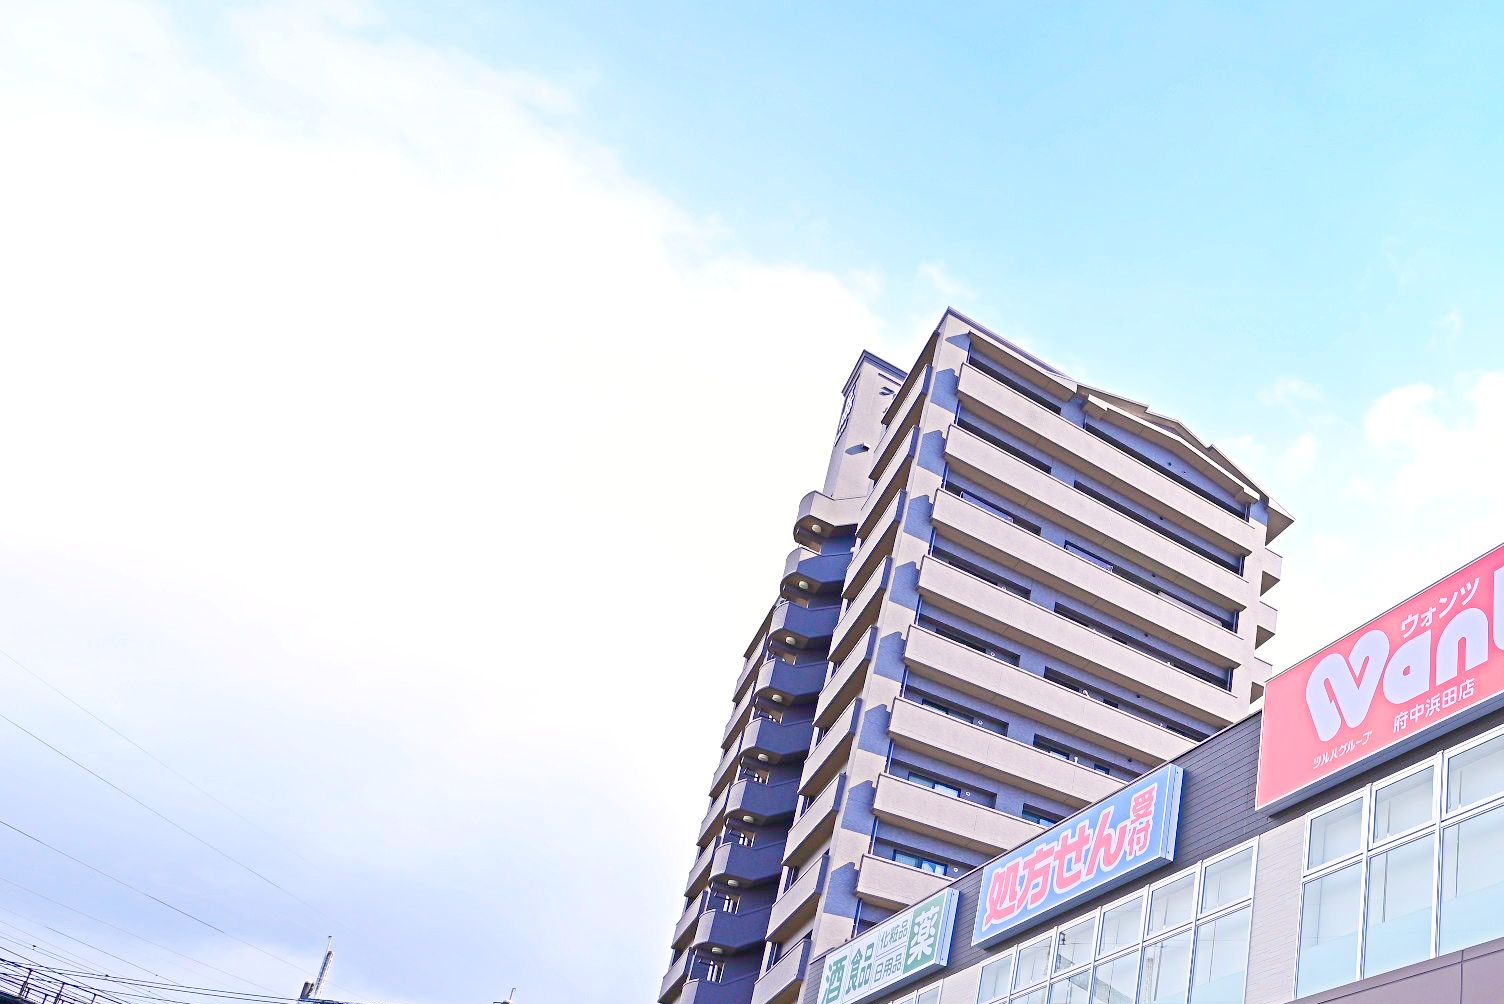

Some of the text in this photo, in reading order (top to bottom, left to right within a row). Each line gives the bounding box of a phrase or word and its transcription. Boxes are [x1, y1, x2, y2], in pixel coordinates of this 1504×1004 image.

[1400, 576, 1480, 638] ウォンツ
[1392, 677, 1475, 733] 府中浜田店
[1312, 730, 1373, 769] ツルハグループ
[880, 919, 910, 949] 化粧品
[907, 906, 940, 966] 薬
[874, 952, 903, 982] 日用品
